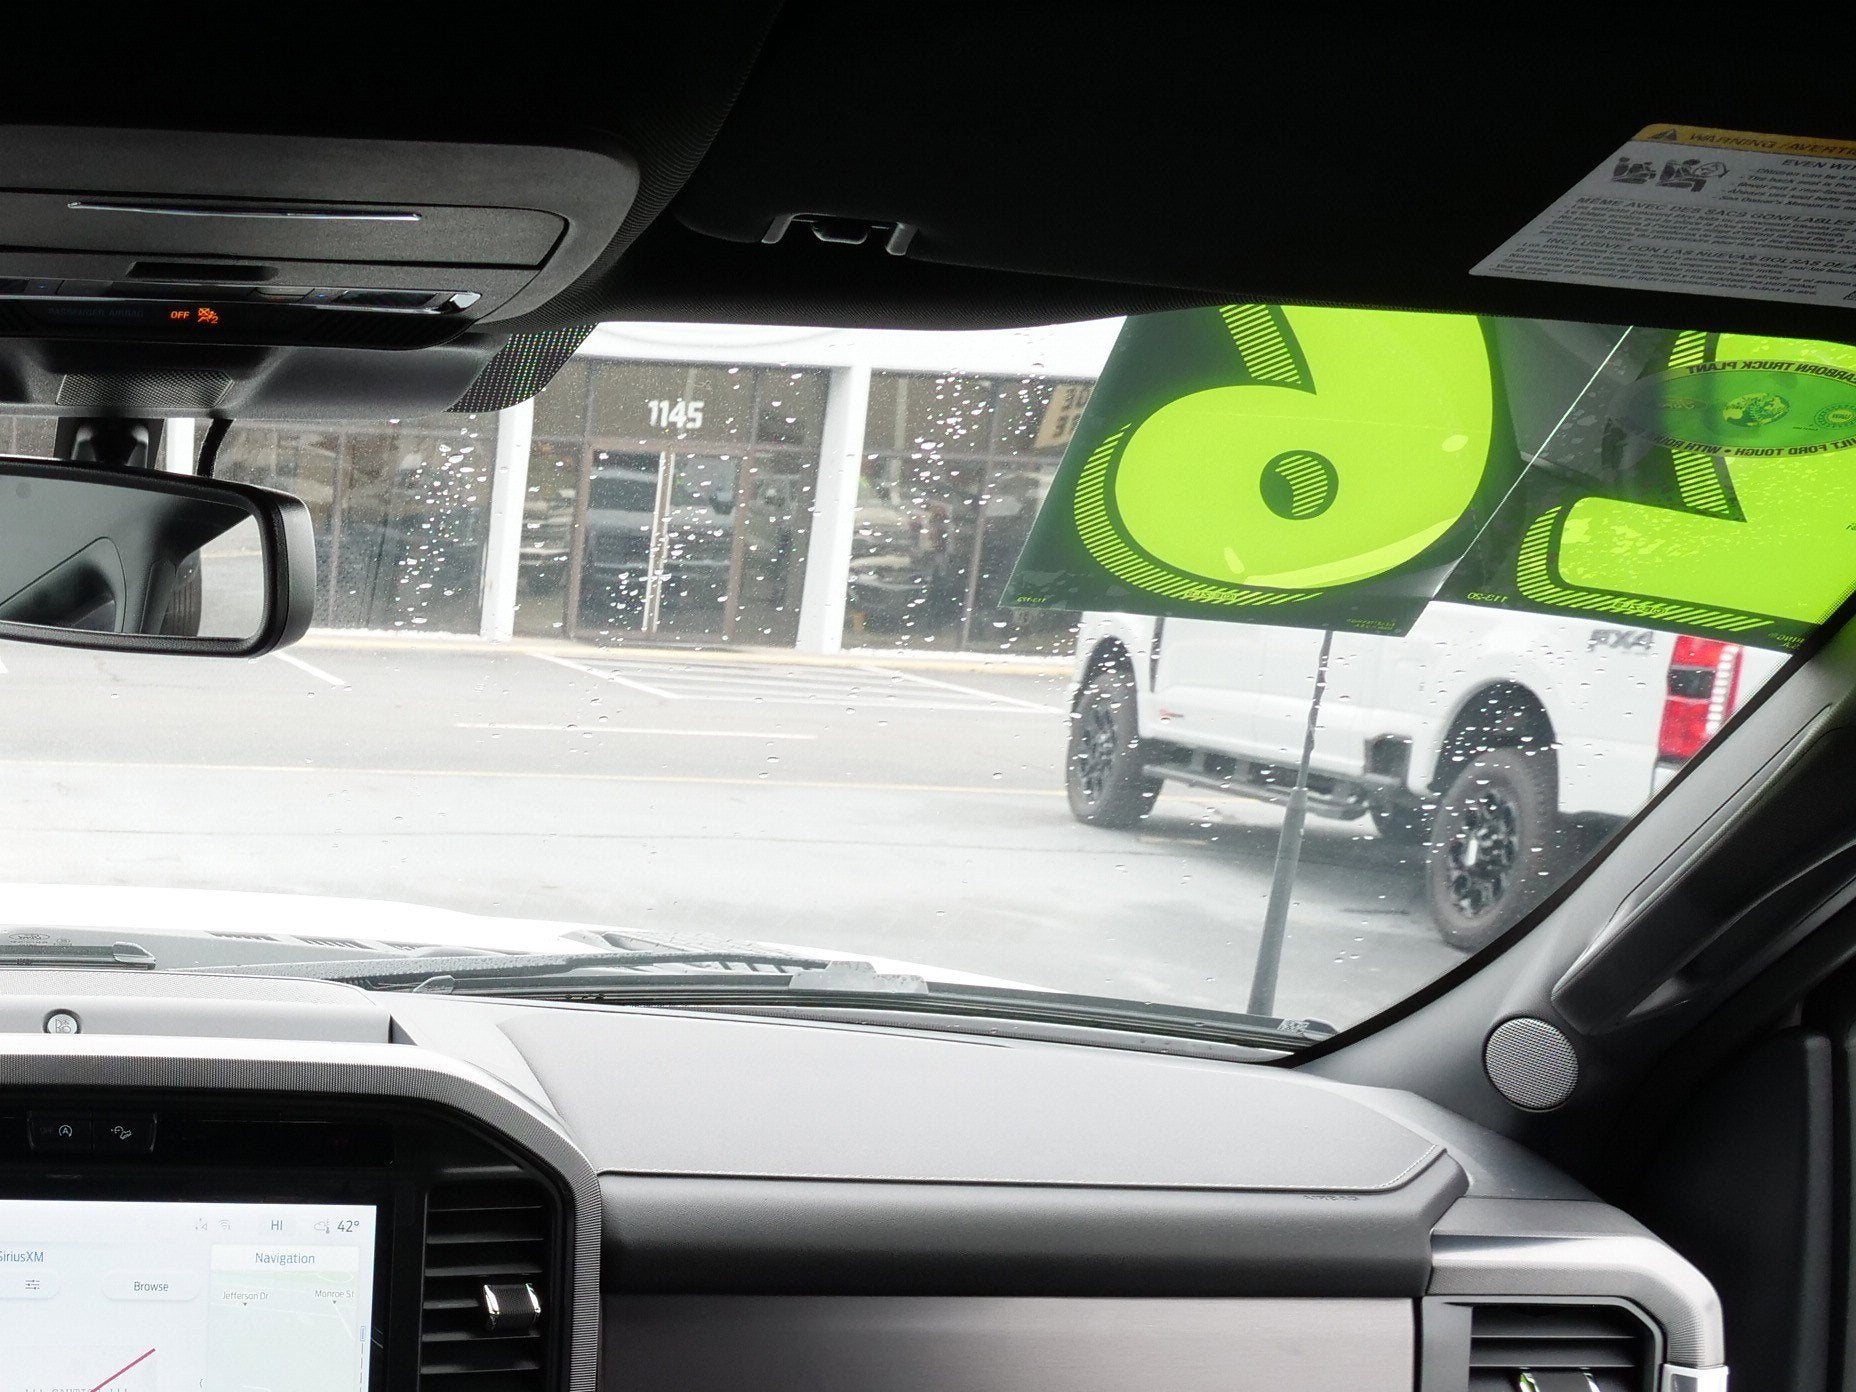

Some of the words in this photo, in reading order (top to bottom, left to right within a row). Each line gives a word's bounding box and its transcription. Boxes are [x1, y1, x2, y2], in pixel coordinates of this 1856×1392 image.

[170, 310, 190, 319] OFF
[648, 400, 704, 429] 1145
[270, 1219, 284, 1232] HI
[336, 1219, 361, 1234] 42°
[254, 1251, 316, 1266] Navigation
[133, 1280, 169, 1292] Browse
[221, 1290, 259, 1301] Jefferson
[259, 1291, 270, 1301] Dr
[314, 1289, 342, 1299] Monroe
[344, 1289, 355, 1299] St
